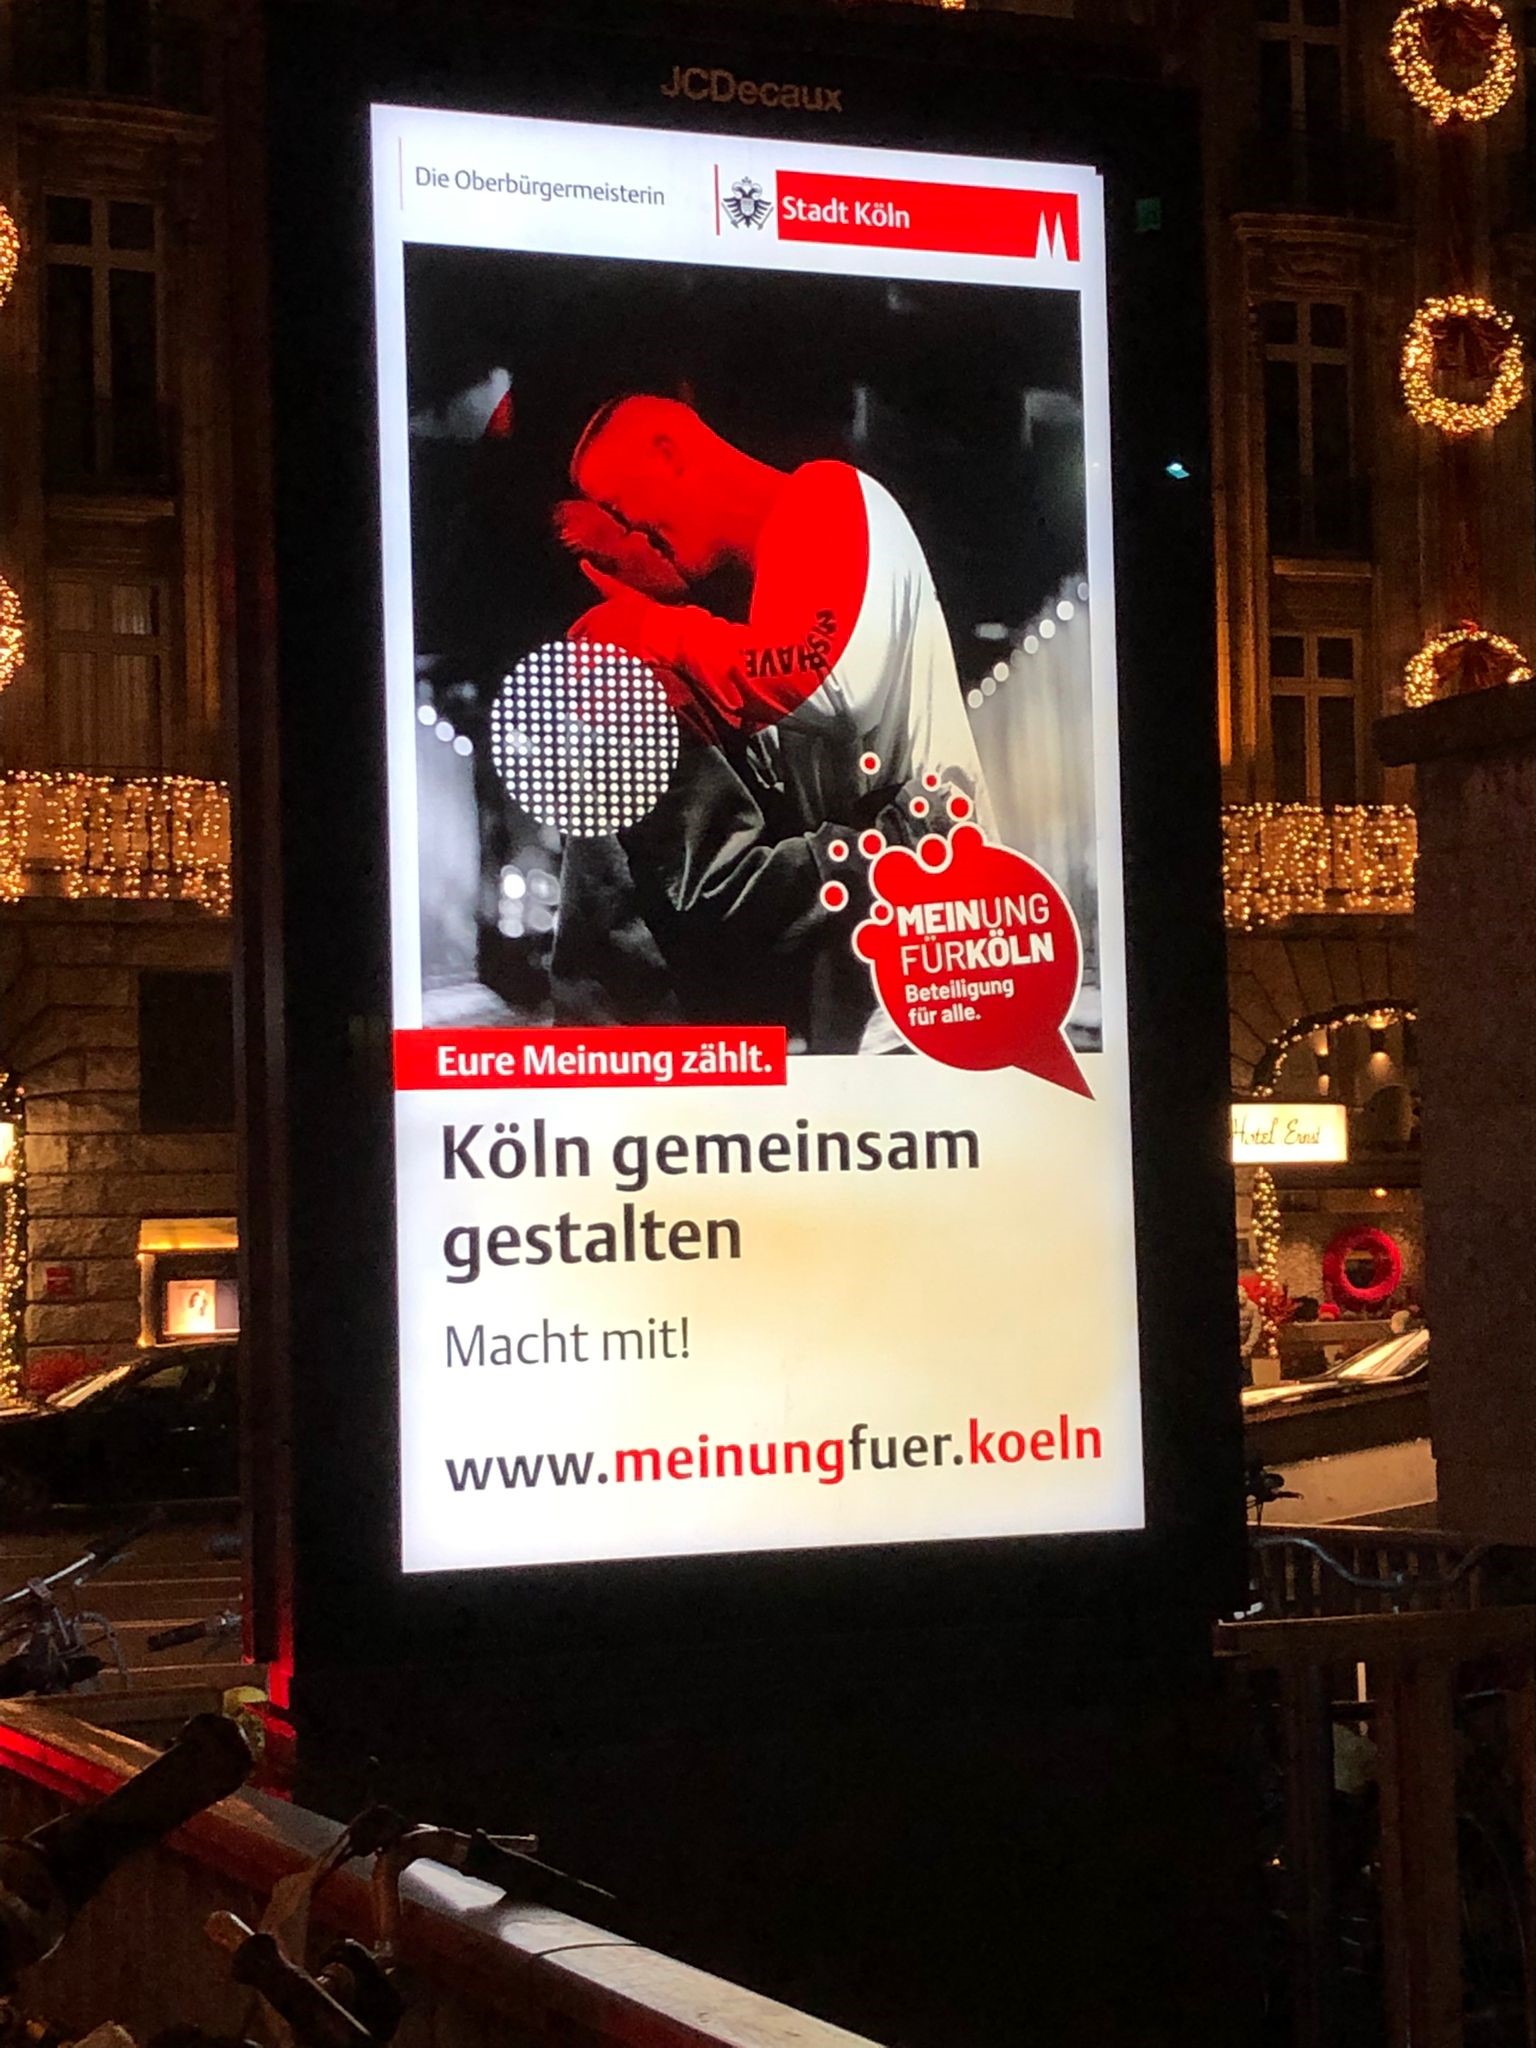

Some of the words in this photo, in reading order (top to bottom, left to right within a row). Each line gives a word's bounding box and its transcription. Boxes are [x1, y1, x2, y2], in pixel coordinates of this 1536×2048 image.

[661, 65, 843, 114] JCDecaux
[415, 166, 450, 188] Die
[454, 169, 666, 206] Oberbürgermeisterin
[782, 193, 850, 226] Stadt
[854, 200, 911, 231] Köln
[896, 893, 1051, 937] MEINUNG
[900, 928, 1055, 976] FÜRKÖLN
[905, 978, 1015, 1004] Beteiligung
[907, 1006, 937, 1027] für
[941, 1003, 982, 1024] alle.
[437, 1046, 515, 1077] Eure
[524, 1045, 674, 1082] Meinung
[682, 1041, 773, 1074] zählt.
[442, 1118, 591, 1180] Köln
[612, 1119, 981, 1193] gemeinsam
[443, 1203, 742, 1284] gestalten
[445, 1318, 589, 1368] Macht
[602, 1316, 691, 1362] mit!
[445, 1414, 1103, 1492] www.meinungfuer.koeln
